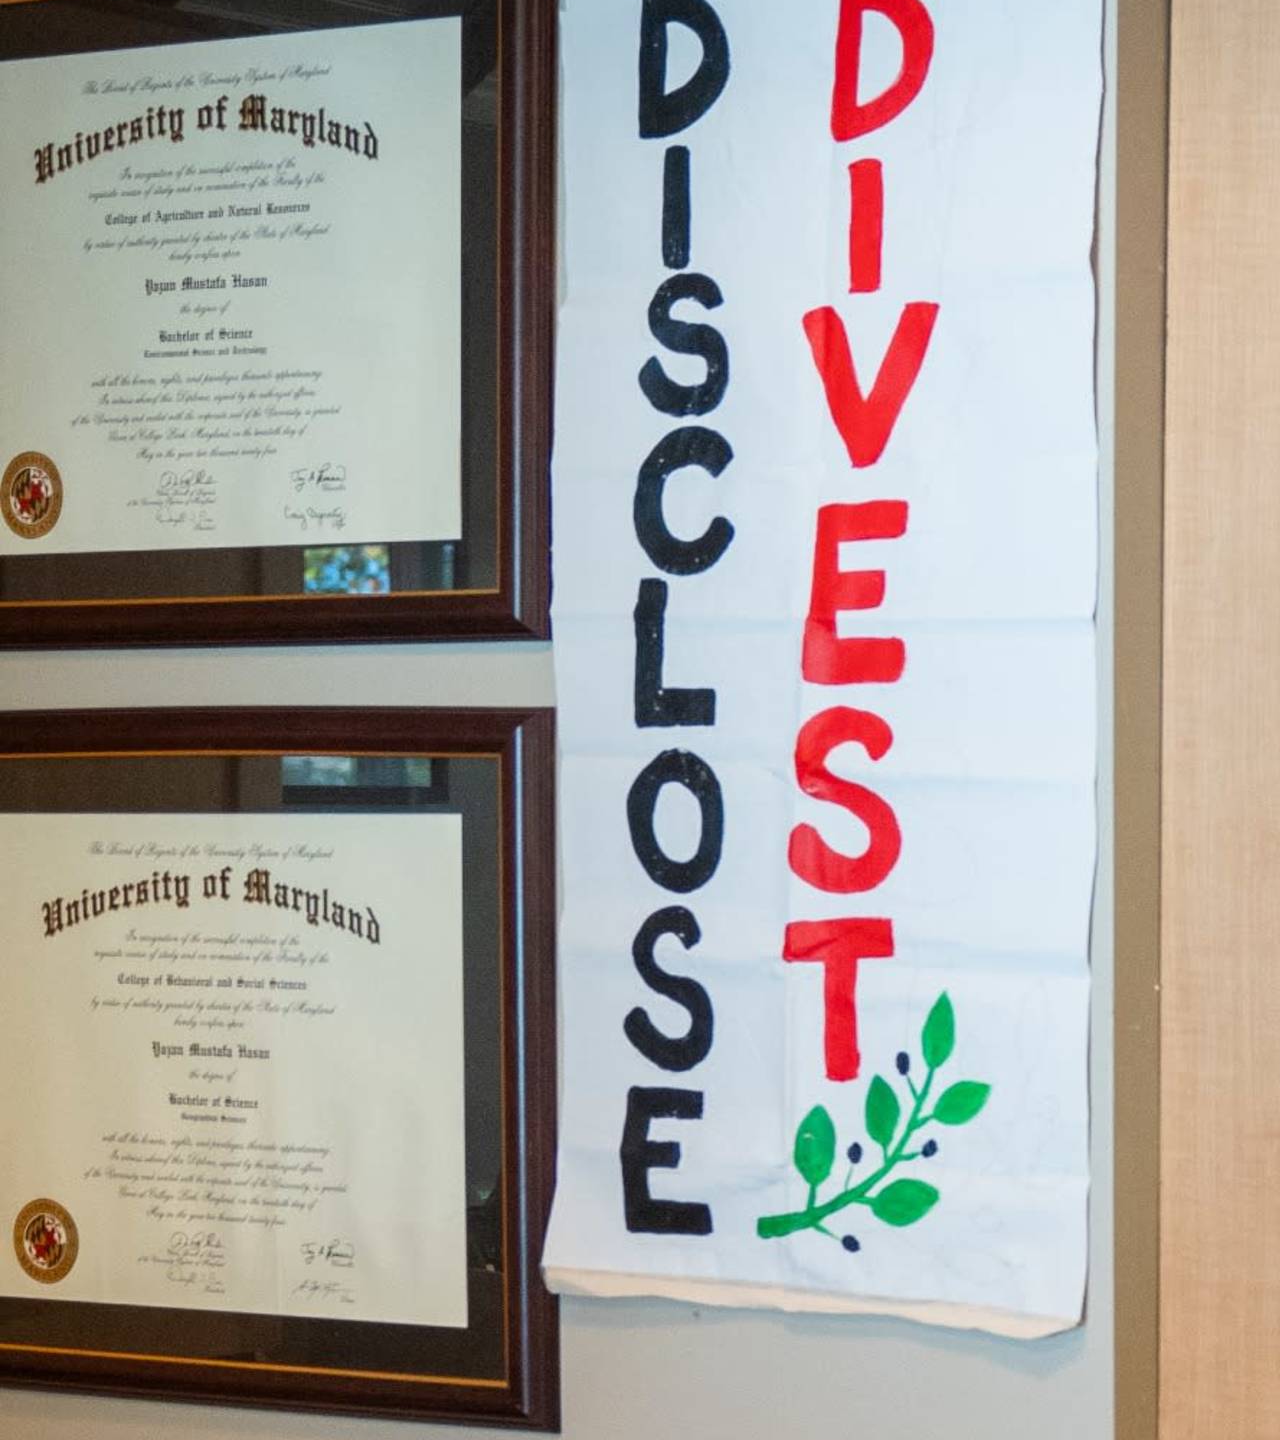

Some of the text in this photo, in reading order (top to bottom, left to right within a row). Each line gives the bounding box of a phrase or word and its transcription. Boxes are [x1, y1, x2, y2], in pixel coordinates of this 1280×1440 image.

[34, 93, 379, 185] University of Maryland
[105, 202, 310, 226] College of Agriculture and Natural Resources
[181, 276, 226, 291] Mustafa
[231, 274, 268, 288] Hasan
[159, 327, 253, 342] Bachelor of Science
[42, 866, 381, 945] University of Maryland
[117, 973, 307, 990] College of Behavioral and Social Sciences
[189, 1043, 232, 1058] Mustafa
[238, 1044, 270, 1059] Hasan
[169, 1093, 258, 1109] Bachelor of Science
